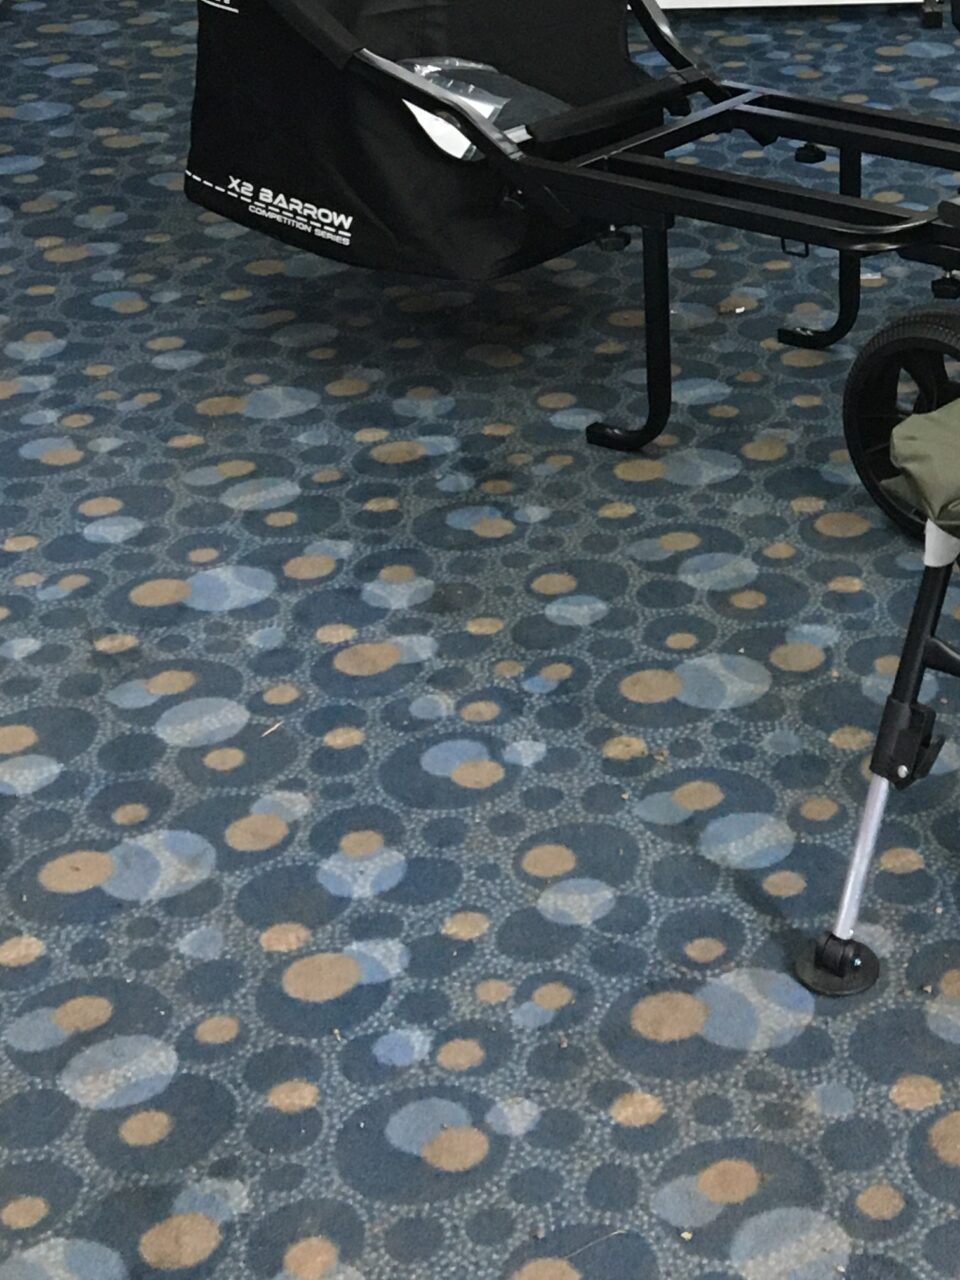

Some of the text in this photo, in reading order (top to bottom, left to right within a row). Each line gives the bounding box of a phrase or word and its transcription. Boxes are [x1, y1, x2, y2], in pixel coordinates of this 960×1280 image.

[228, 175, 353, 230] X2 BARROW
[248, 205, 350, 246] COMPETITION SERIES
